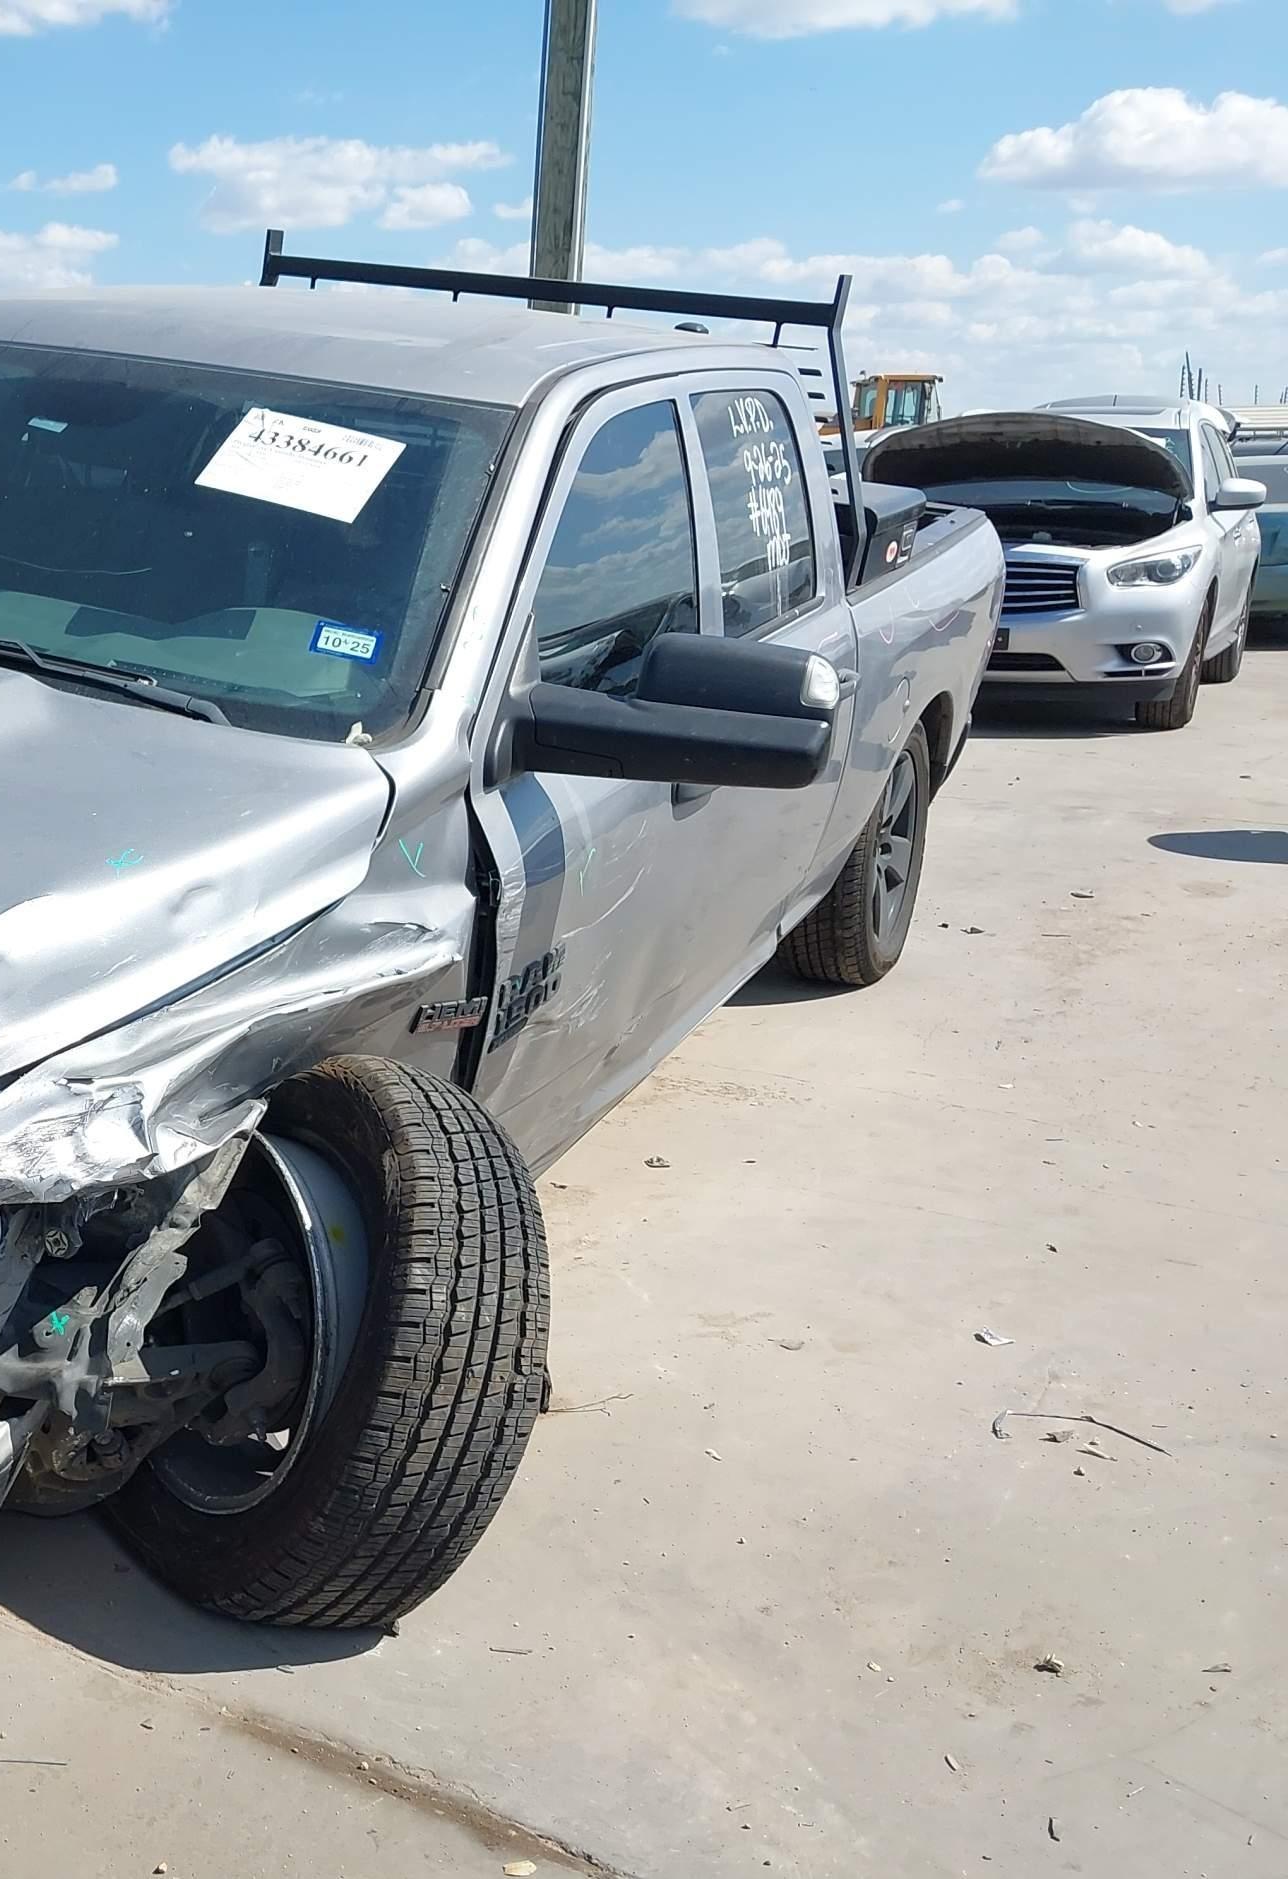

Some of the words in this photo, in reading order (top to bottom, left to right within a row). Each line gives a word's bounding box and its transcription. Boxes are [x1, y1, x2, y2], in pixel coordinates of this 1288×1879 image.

[248, 428, 369, 468] 43384661
[323, 635, 342, 649] 10
[349, 641, 370, 655] 25
[419, 996, 489, 1024] HEMI
